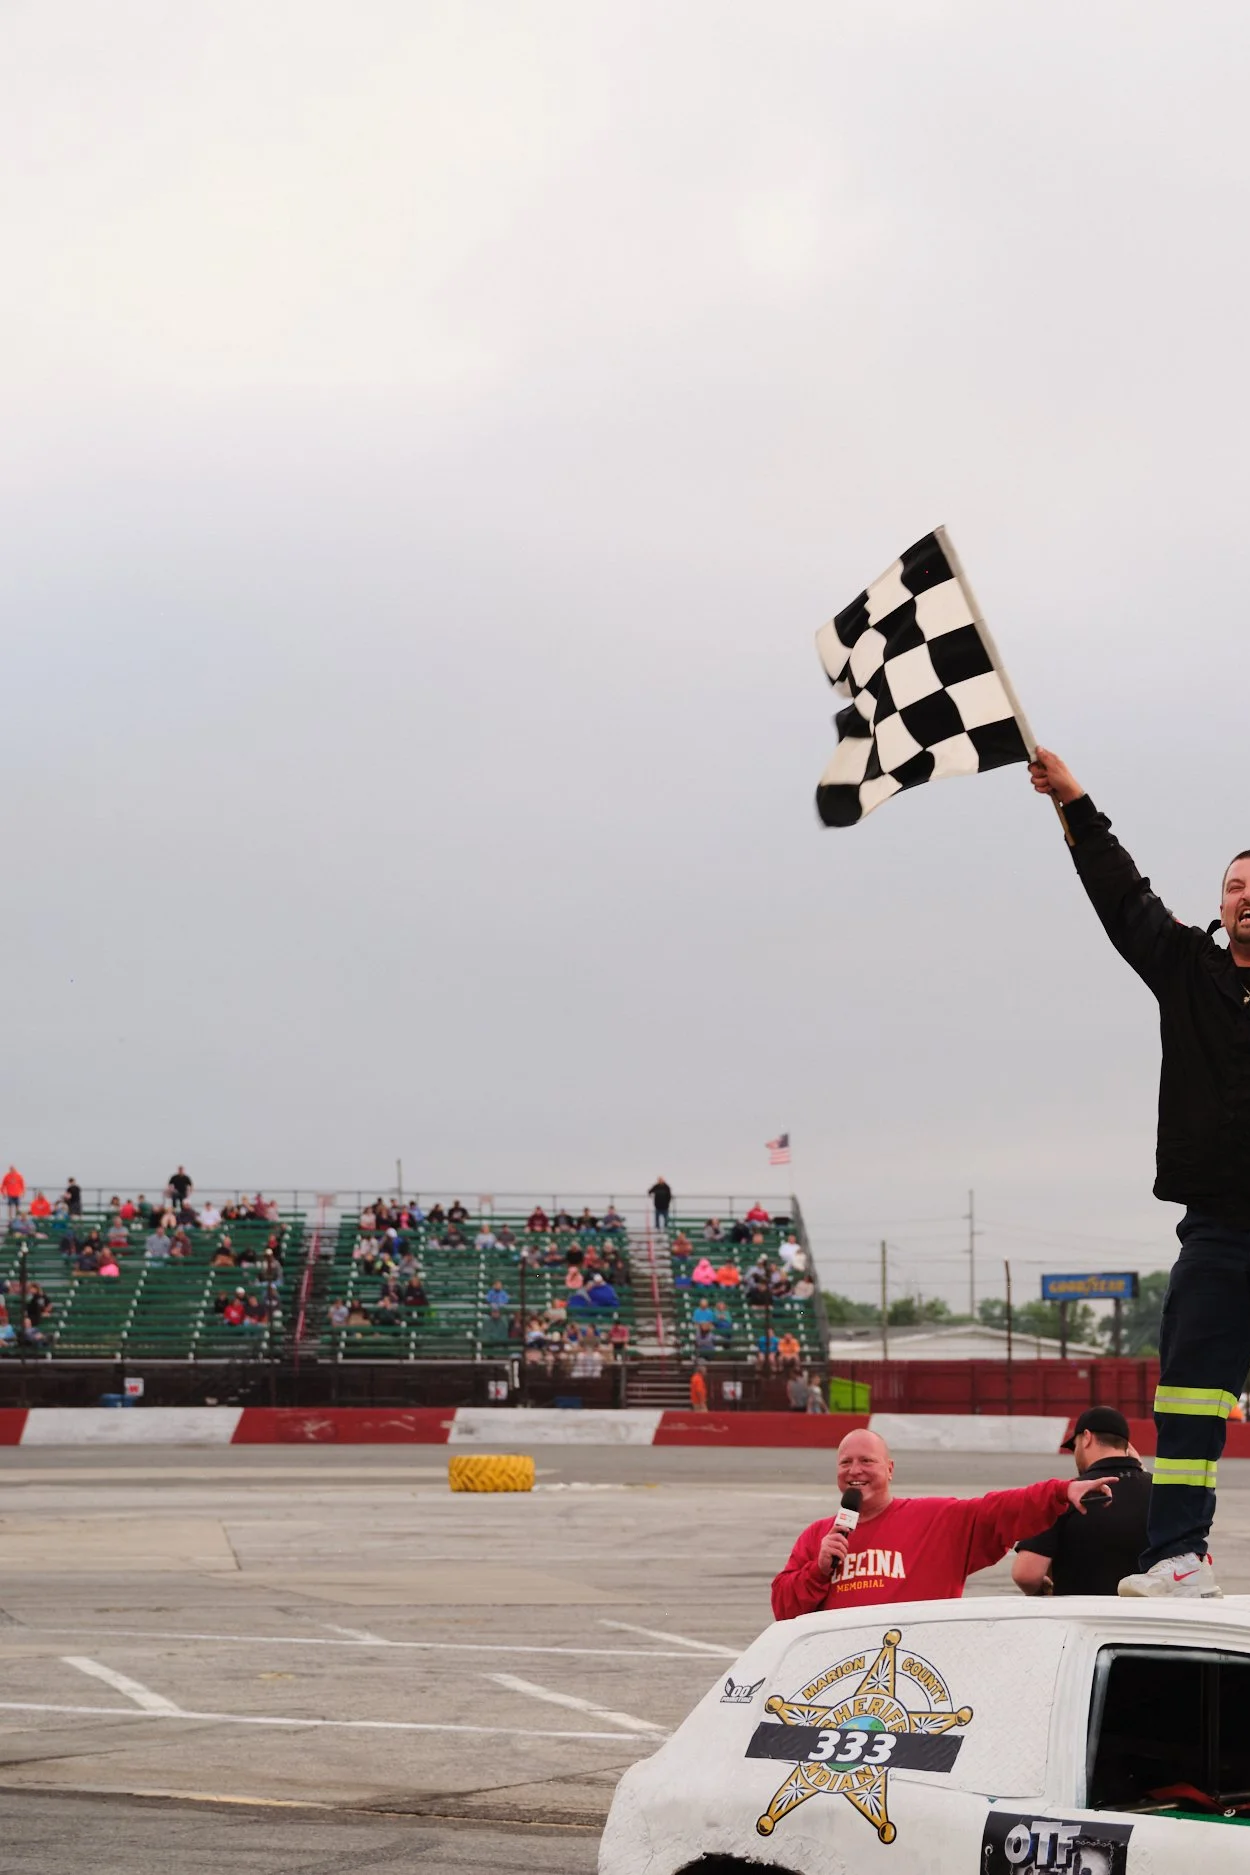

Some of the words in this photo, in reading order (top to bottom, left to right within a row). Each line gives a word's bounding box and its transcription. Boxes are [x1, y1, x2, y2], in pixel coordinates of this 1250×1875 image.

[837, 1579, 885, 1593] MEMORIAL
[802, 1656, 866, 1701] MARION
[902, 1657, 949, 1705] COUNTY
[808, 1729, 898, 1764] 333
